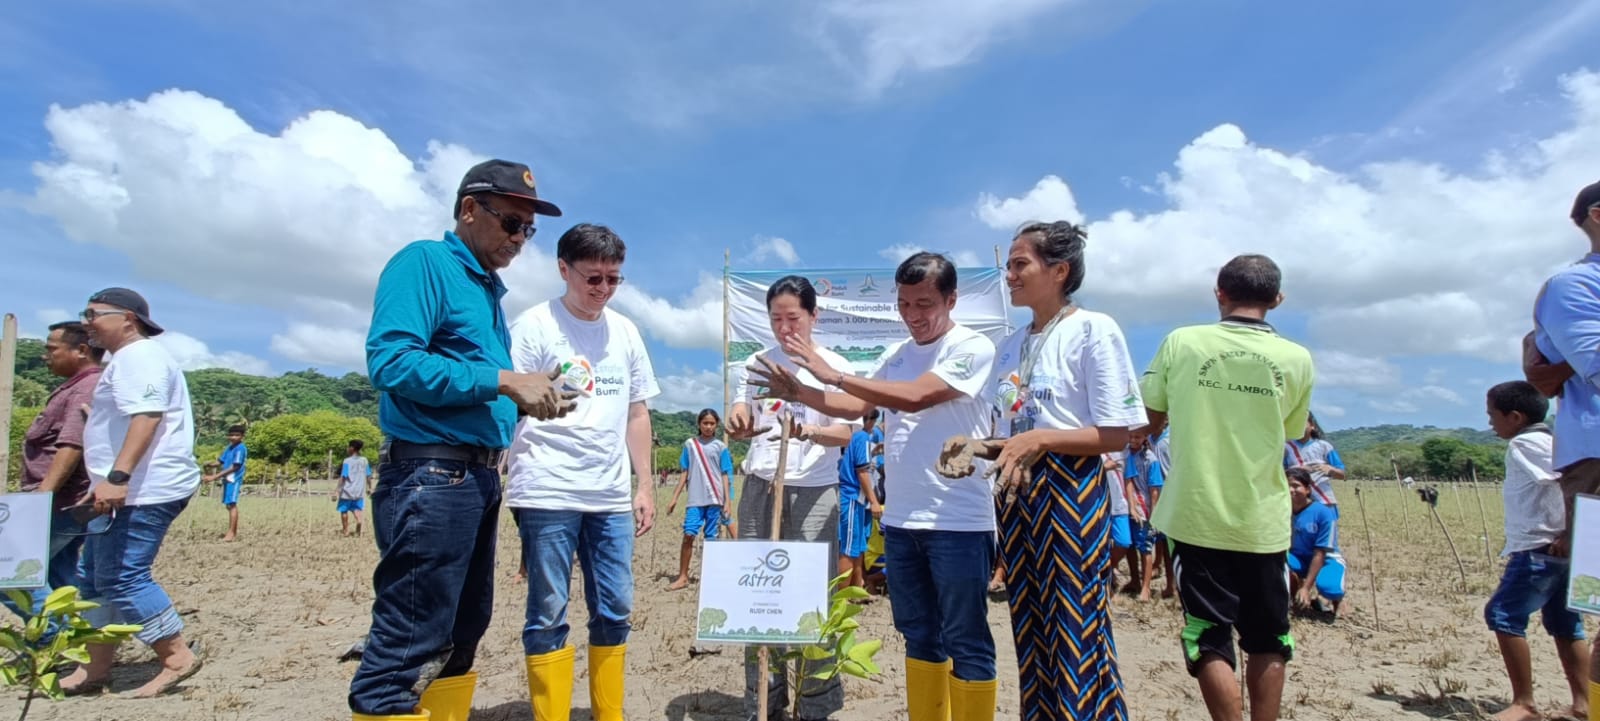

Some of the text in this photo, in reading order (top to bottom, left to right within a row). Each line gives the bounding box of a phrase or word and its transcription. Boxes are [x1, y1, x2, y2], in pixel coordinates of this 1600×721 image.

[840, 303, 892, 312] Sustainable
[594, 375, 624, 386] Peduli
[1198, 379, 1222, 389] KEC.
[595, 387, 620, 397] Bumi
[738, 569, 784, 588] astra
[749, 607, 783, 615] RUDY CHEN
